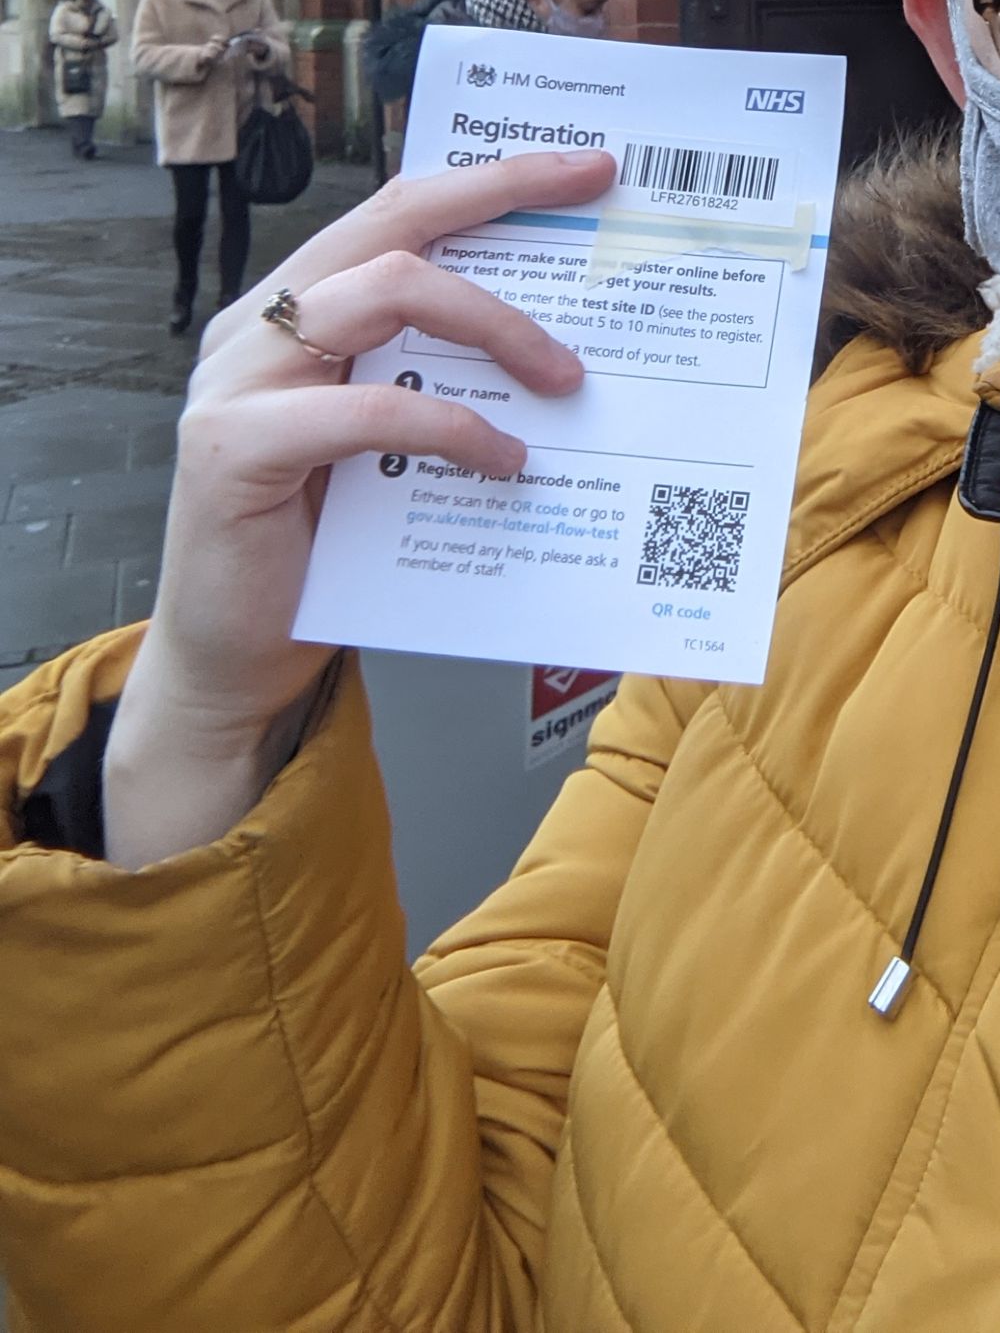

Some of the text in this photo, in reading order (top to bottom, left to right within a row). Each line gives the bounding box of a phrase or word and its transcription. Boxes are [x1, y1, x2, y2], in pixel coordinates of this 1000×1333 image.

[502, 71, 626, 97] HM Government
[746, 88, 803, 113] NHS
[451, 112, 606, 148] Registration
[446, 148, 503, 168] card
[650, 191, 739, 211] LFR27618242
[441, 246, 514, 261] Important:
[518, 252, 555, 265] make
[558, 255, 588, 267] sure
[622, 260, 673, 275] gister
[676, 266, 719, 280] online
[723, 268, 766, 283] before
[473, 264, 498, 277] test
[502, 268, 516, 278] or
[519, 269, 547, 281] you
[551, 270, 576, 282] will
[606, 276, 630, 289] get
[632, 278, 666, 291] your
[669, 282, 717, 297] results.
[504, 290, 517, 301] to
[520, 292, 554, 305] enter
[558, 294, 577, 307] the
[582, 297, 608, 311] test
[611, 300, 636, 314] site
[640, 303, 655, 316] ID
[658, 304, 684, 319] (see
[687, 308, 707, 322] the
[709, 312, 754, 326] posters
[521, 308, 763, 344] akes about 5 to 10 minutes to register.
[583, 345, 623, 359] record
[627, 348, 641, 361] of
[643, 352, 672, 365] your
[675, 354, 701, 367] test.
[402, 376, 511, 402] 1 Your name
[386, 455, 400, 472] 2
[416, 461, 475, 479] Register
[517, 472, 573, 488] barcode
[577, 477, 621, 492] online
[410, 489, 625, 522] Either scan the QR code or go to
[406, 511, 620, 541] gov.uk/enter-lateral-flow-test
[400, 534, 619, 568] If you need any help, please ask a
[396, 556, 507, 578] member of staff.
[652, 602, 711, 620] QR code
[684, 638, 725, 652] TC1564
